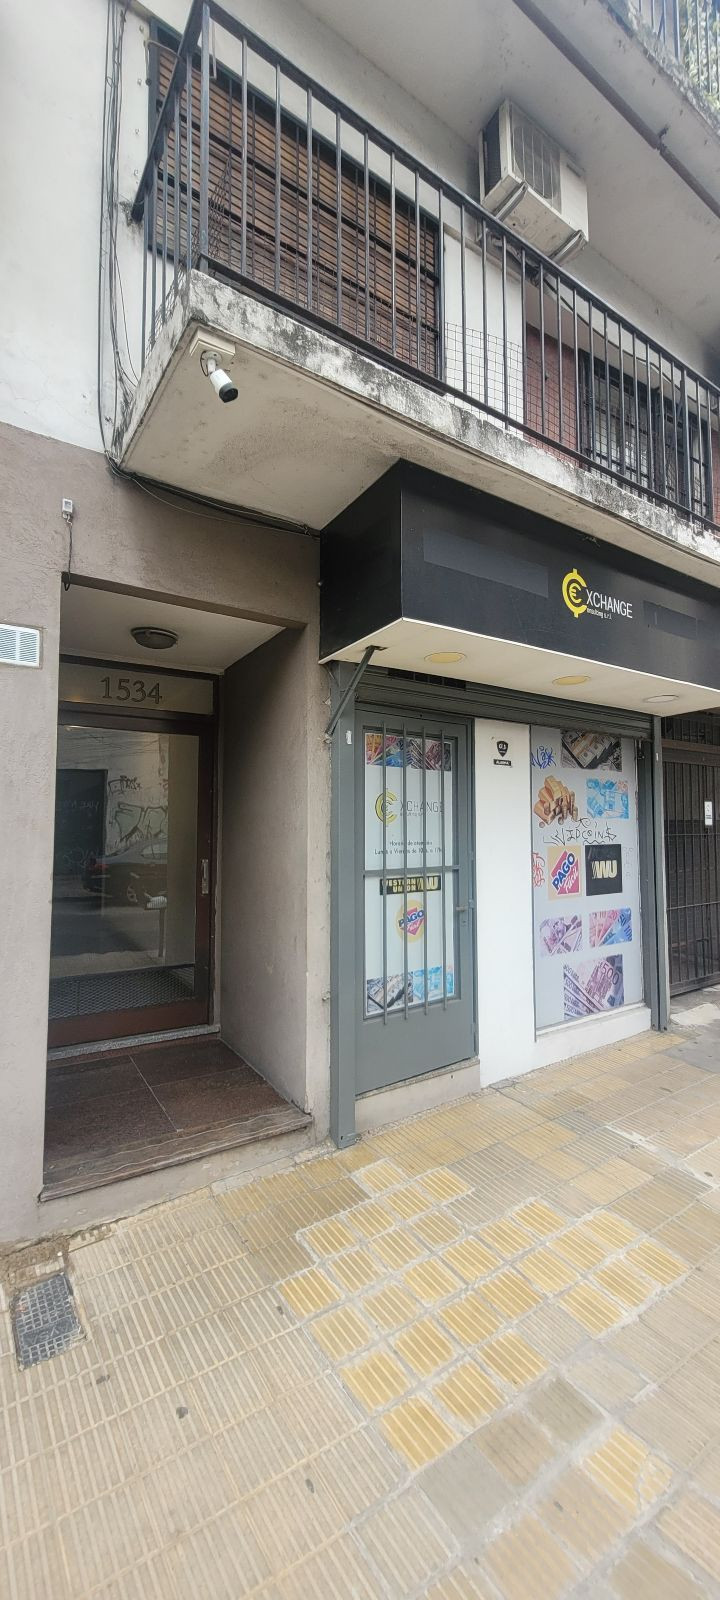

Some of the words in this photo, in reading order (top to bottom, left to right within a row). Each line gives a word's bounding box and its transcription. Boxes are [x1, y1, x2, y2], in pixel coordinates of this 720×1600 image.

[100, 676, 163, 705] 1534
[551, 852, 576, 892] PAGO
[592, 860, 618, 879] WU
[393, 885, 416, 893] UNON
